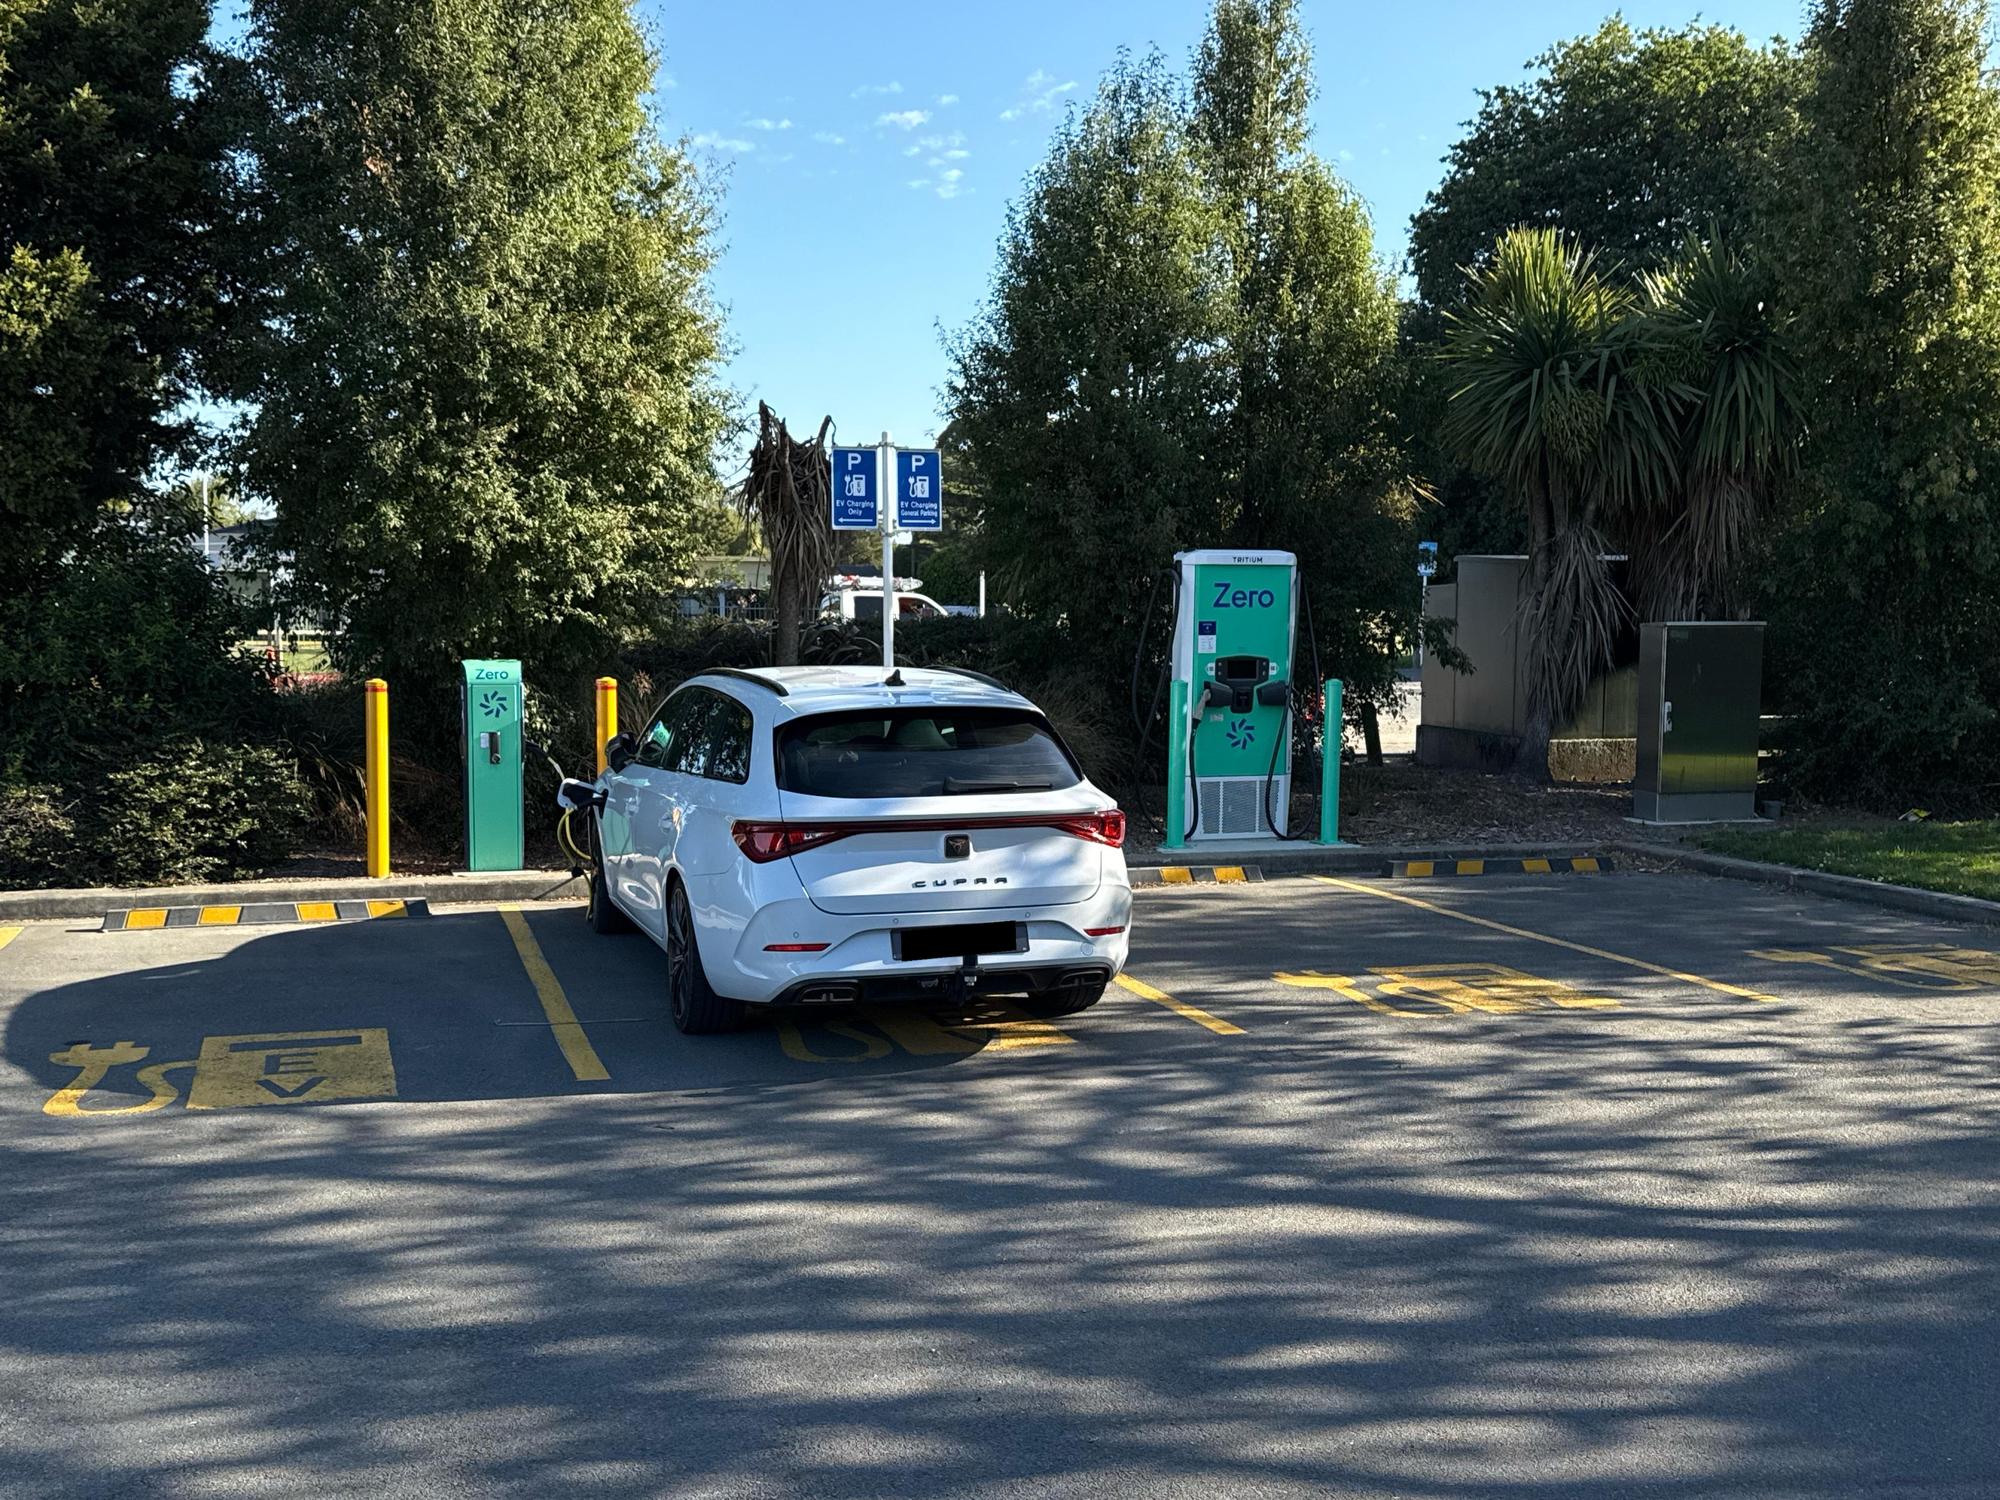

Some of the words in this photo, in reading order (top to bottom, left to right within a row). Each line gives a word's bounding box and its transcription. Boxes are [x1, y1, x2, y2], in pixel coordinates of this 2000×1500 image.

[848, 453, 862, 471] P
[911, 455, 925, 472] P
[847, 500, 874, 508] Charging
[911, 502, 937, 510] Charging
[848, 508, 862, 516] Only
[920, 510, 938, 518] Parking
[1213, 582, 1275, 609] Zero
[475, 669, 509, 680] Zero
[912, 877, 1008, 889] CUPRA
